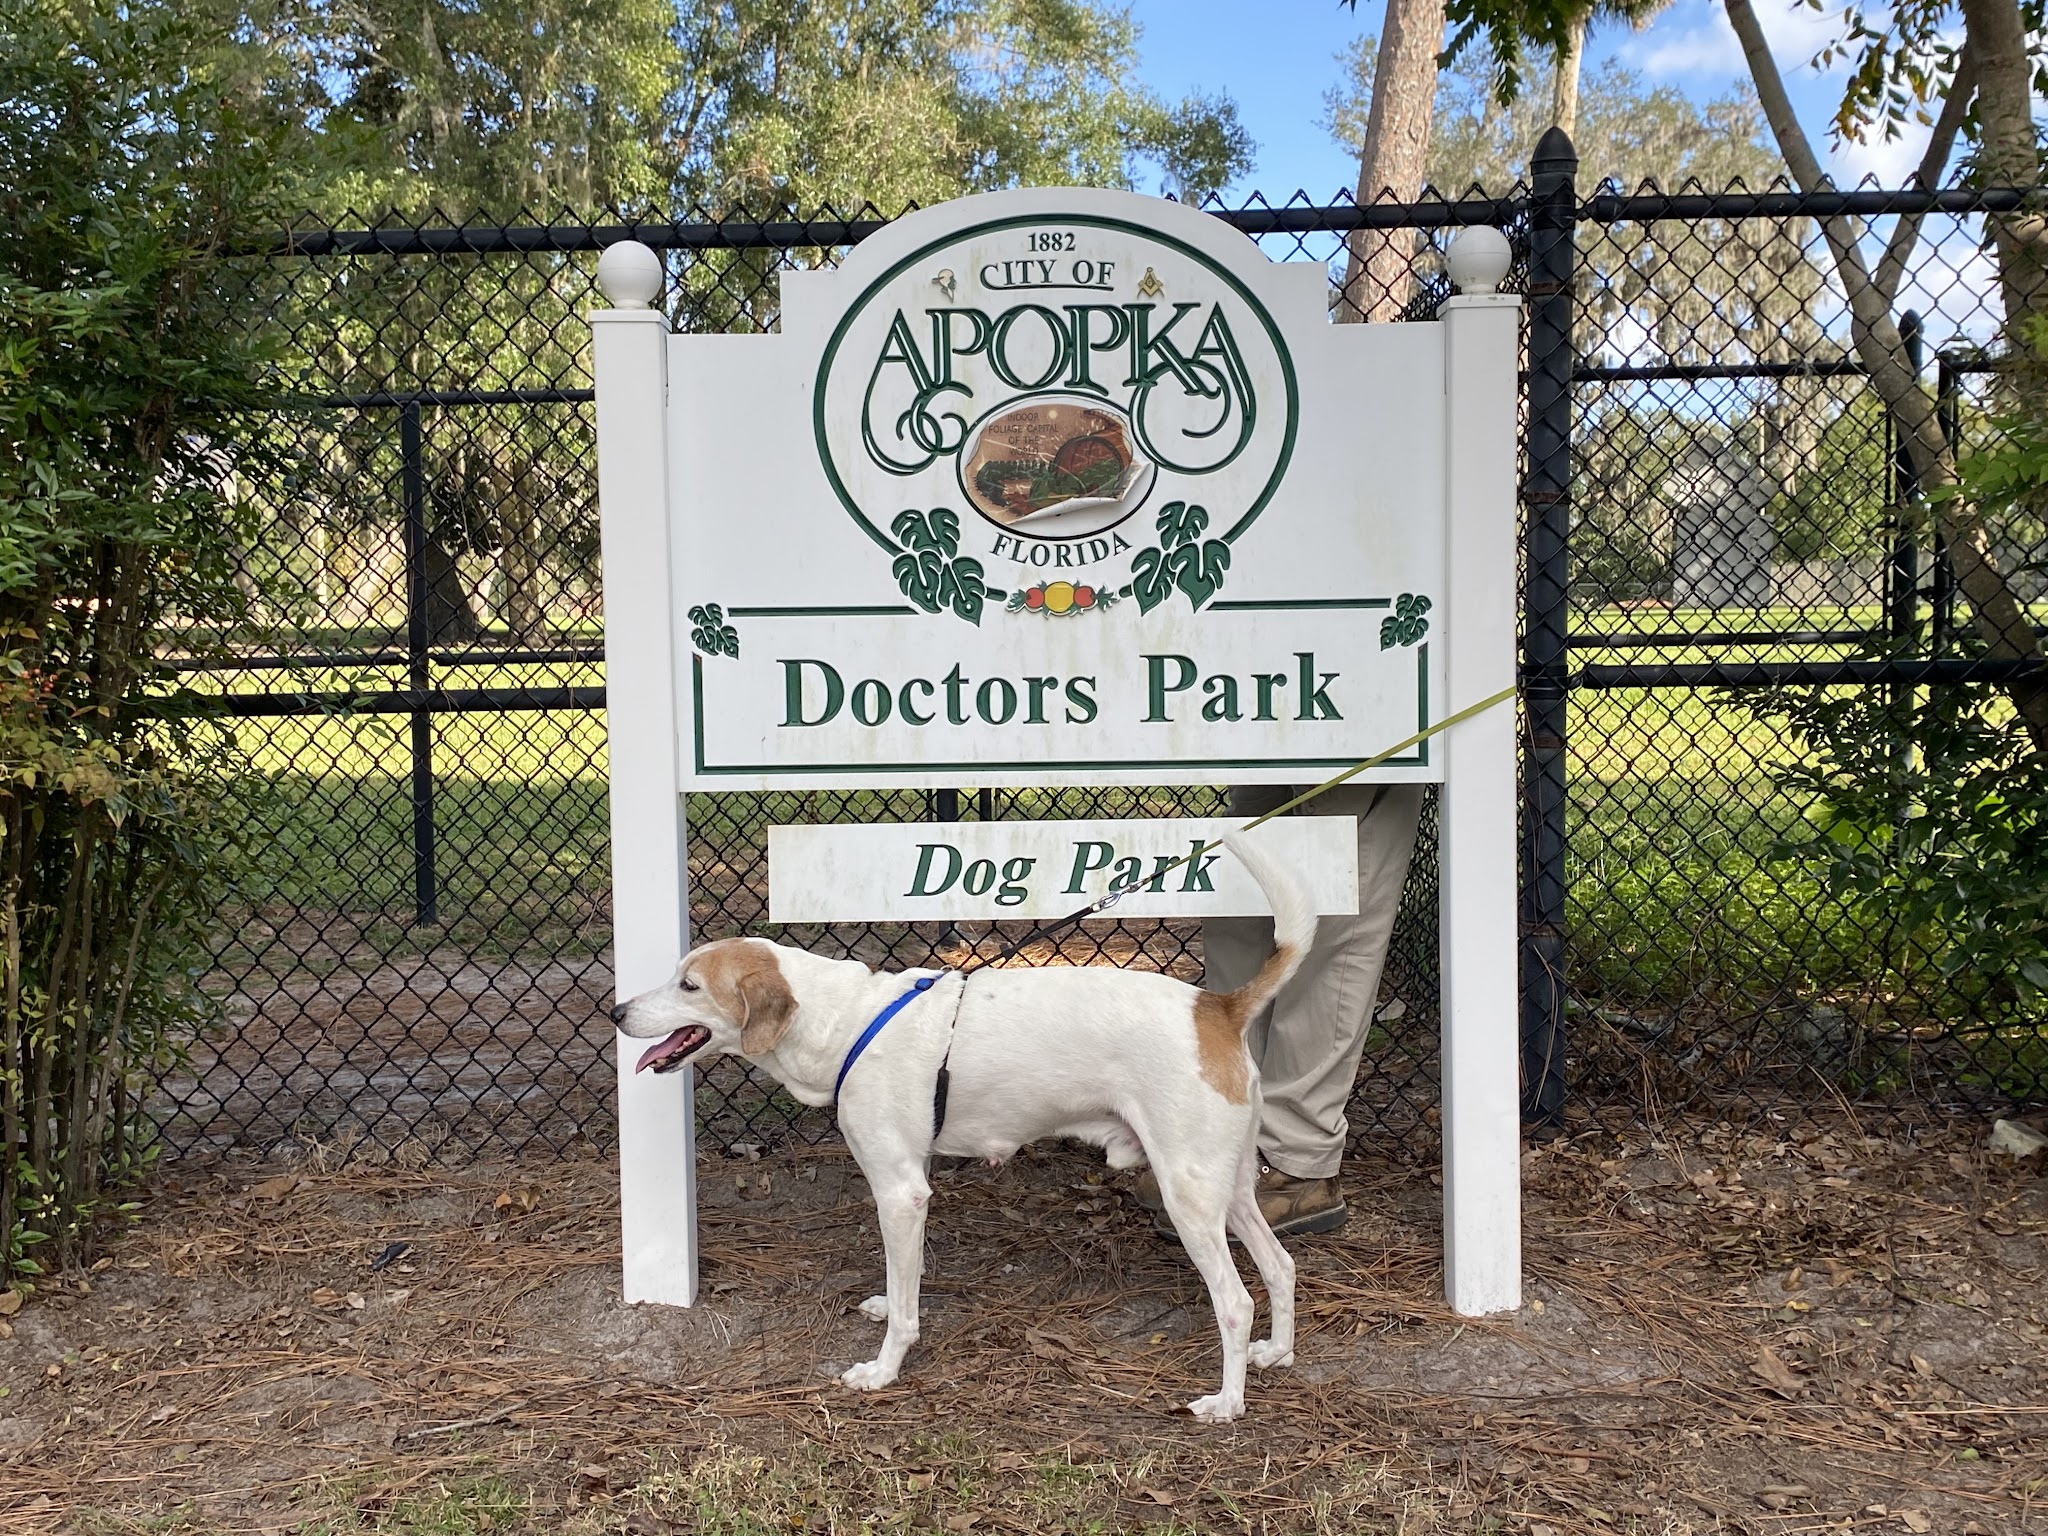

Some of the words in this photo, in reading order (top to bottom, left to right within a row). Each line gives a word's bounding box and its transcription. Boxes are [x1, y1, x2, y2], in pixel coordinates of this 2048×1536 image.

[1027, 231, 1077, 253] 1882
[979, 258, 1058, 291] CITY
[1072, 259, 1116, 285] OF
[861, 301, 1258, 475] APOPKA
[988, 424, 1023, 434] FOLIAGE
[1026, 424, 1060, 434] CAPITAL
[1007, 412, 1040, 422] INDOOR
[1008, 436, 1020, 445] OF
[1023, 435, 1040, 445] THE
[1009, 447, 1040, 456] WORLD
[988, 530, 1133, 568] FLORIDA
[775, 658, 1099, 728] Doctors
[1139, 651, 1345, 722] Park
[903, 843, 1037, 907] Dog
[1059, 839, 1222, 894] Park
